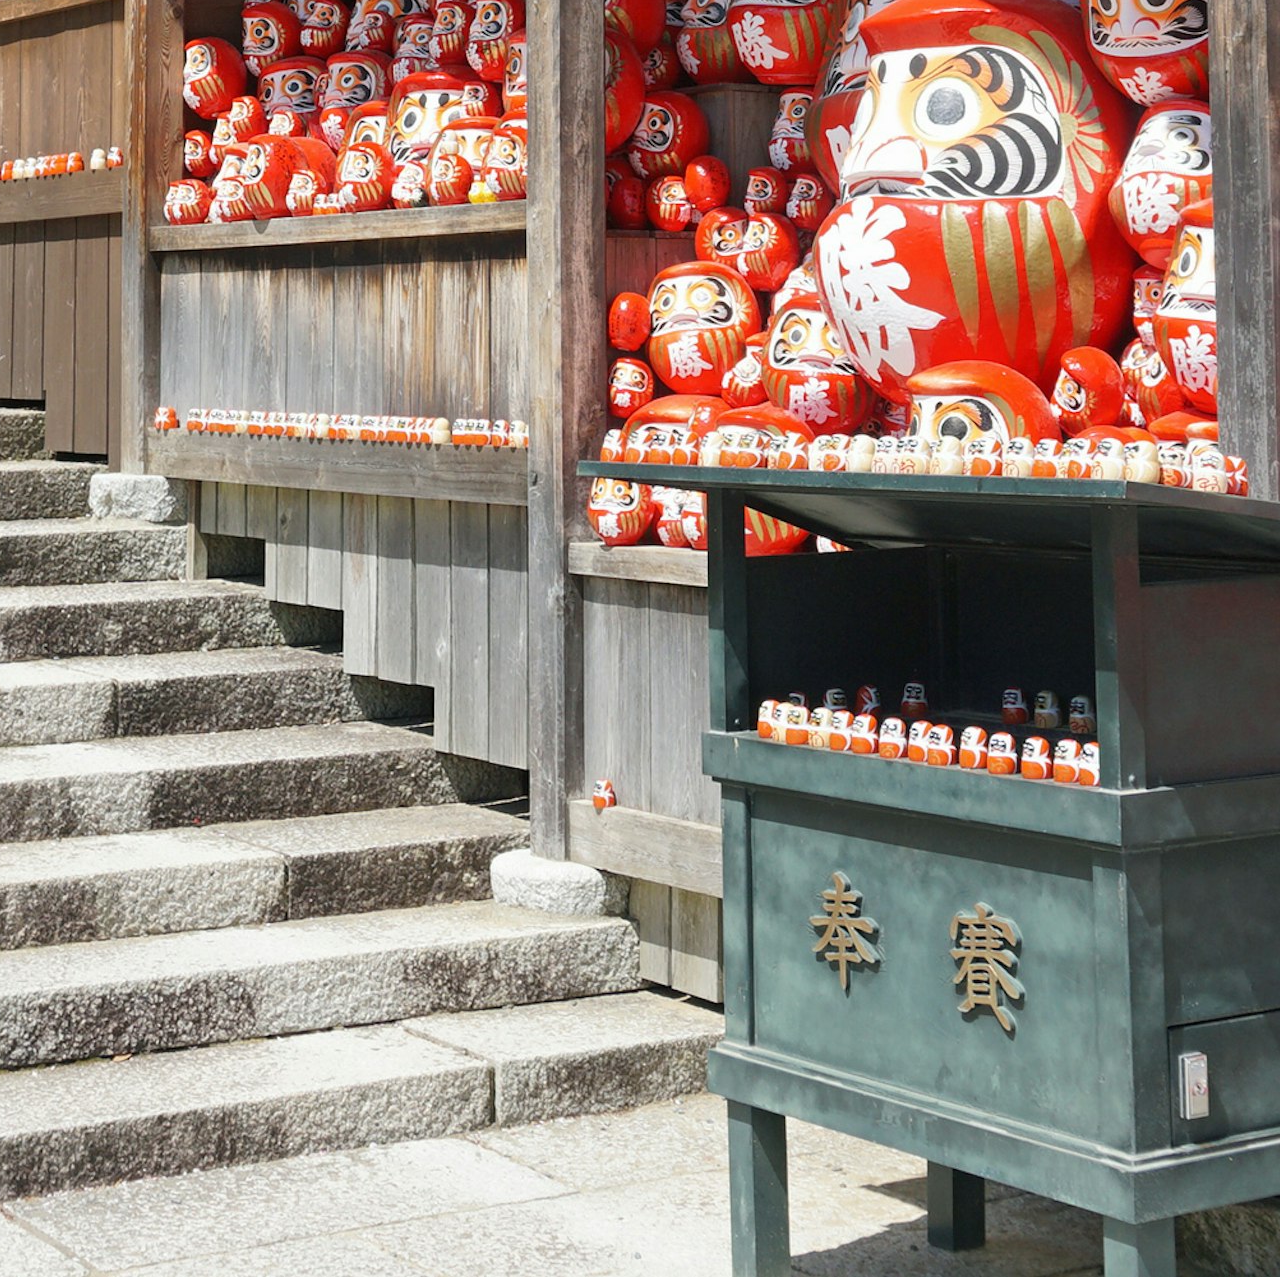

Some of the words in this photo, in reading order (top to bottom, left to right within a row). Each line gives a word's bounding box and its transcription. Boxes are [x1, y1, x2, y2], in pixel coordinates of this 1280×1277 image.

[731, 11, 789, 69] 勝
[1123, 173, 1181, 235] 勝
[820, 196, 945, 383] 勝
[667, 336, 713, 380] 勝
[1170, 325, 1217, 394] 勝
[788, 377, 835, 423] 勝
